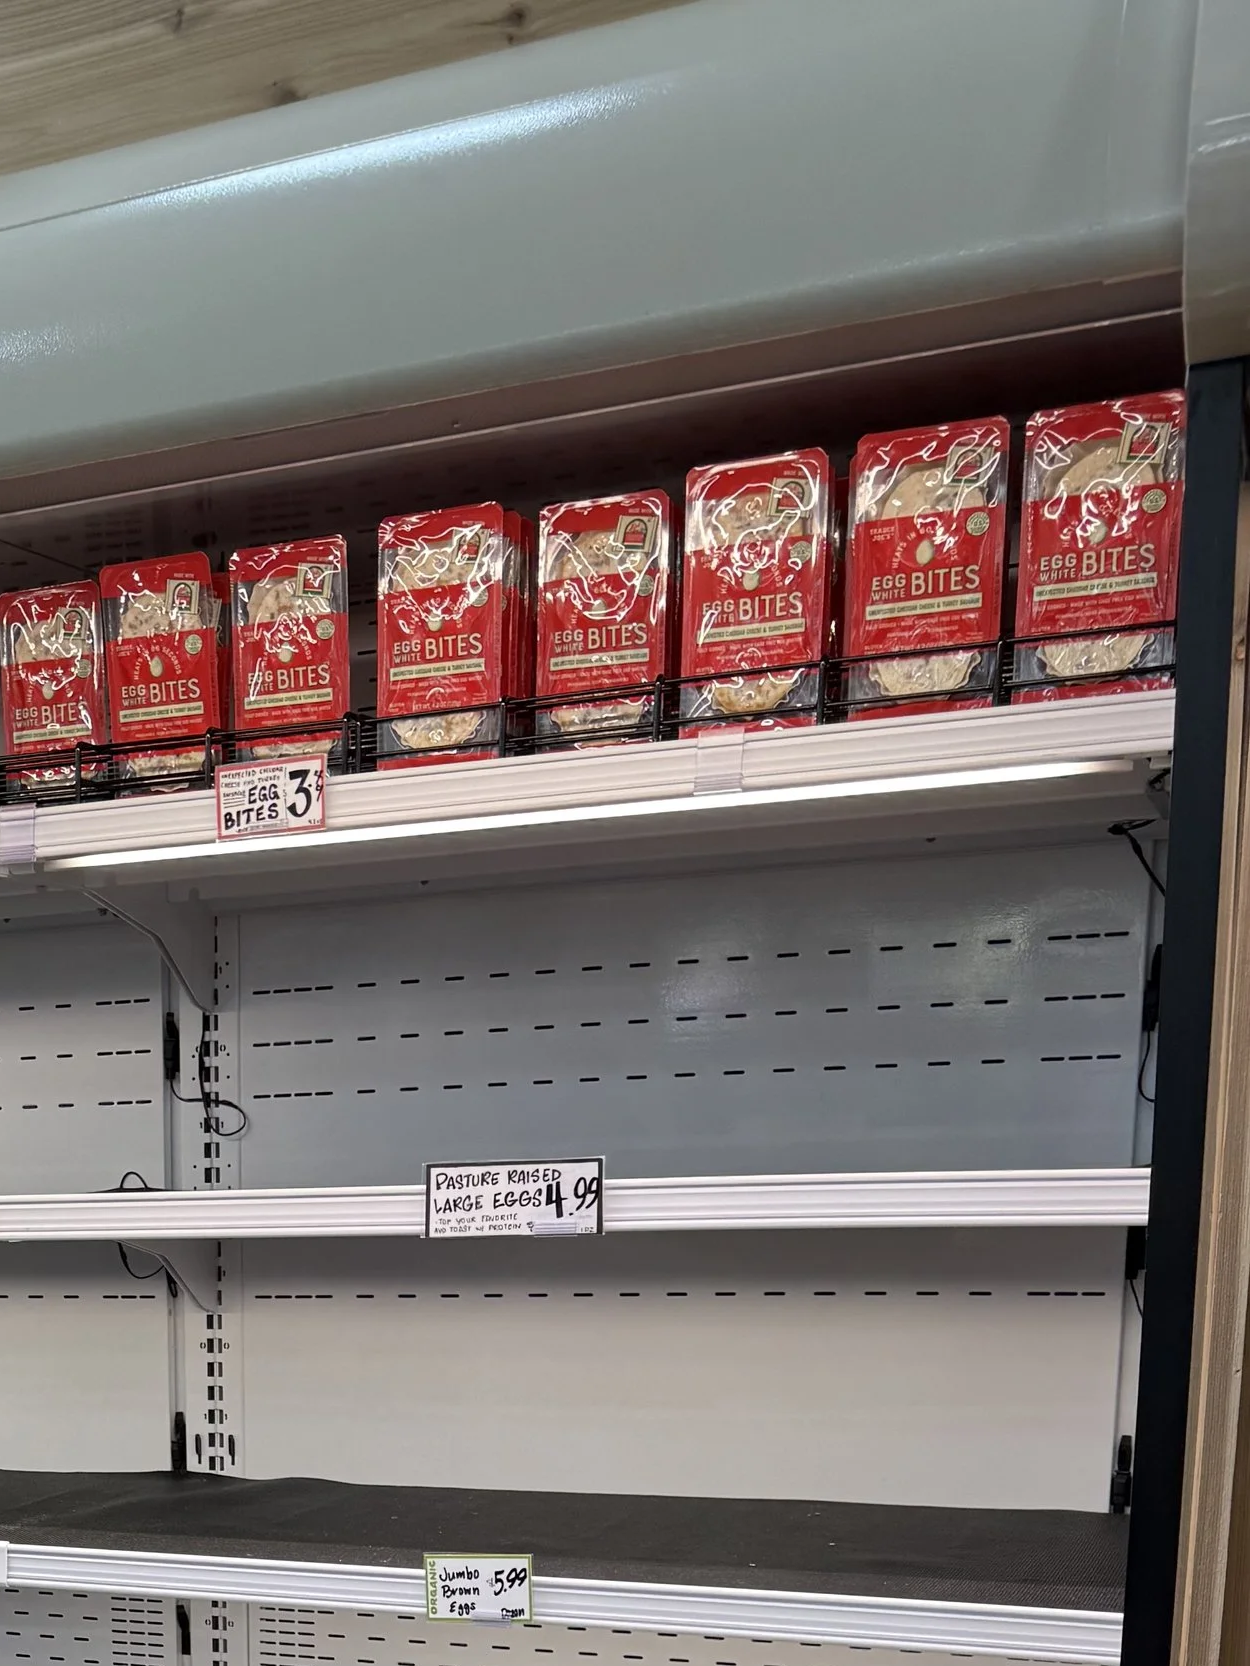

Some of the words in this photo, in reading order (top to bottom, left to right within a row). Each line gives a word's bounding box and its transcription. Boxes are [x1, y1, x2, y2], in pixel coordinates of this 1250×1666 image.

[1040, 553, 1077, 570] EGG
[1082, 543, 1156, 576] BITES
[872, 574, 906, 591] EGG
[911, 564, 980, 596] BITES
[1039, 567, 1077, 582] WHITE
[871, 588, 906, 600] WHITE
[703, 601, 734, 615] EGG
[739, 592, 802, 621] BITES
[393, 639, 421, 654] EGG
[425, 633, 483, 660] BITES
[554, 629, 584, 644] EGG
[588, 623, 647, 650] BITES
[554, 642, 584, 653] WHITE
[393, 652, 421, 664] WHITE
[277, 664, 330, 690] BITES
[121, 684, 146, 698] EGG
[149, 678, 200, 704] BITES
[122, 697, 147, 707] WHITE
[15, 707, 38, 720] EGG
[15, 719, 38, 728] WHITE
[248, 783, 280, 805] EGG
[224, 803, 279, 831] BITES
[436, 1172, 500, 1190] PASTURE
[508, 1168, 562, 1185] RAISED
[434, 1195, 484, 1214] LARGE
[493, 1188, 543, 1210] EGGS
[545, 1177, 600, 1219] 4.99
[455, 1216, 477, 1224] YOUR
[481, 1213, 518, 1223] FAVORITE
[439, 1566, 480, 1583] Jumbo
[429, 1560, 438, 1615] ORGANIC
[441, 1584, 480, 1598] Brown
[450, 1601, 476, 1616] Eggs
